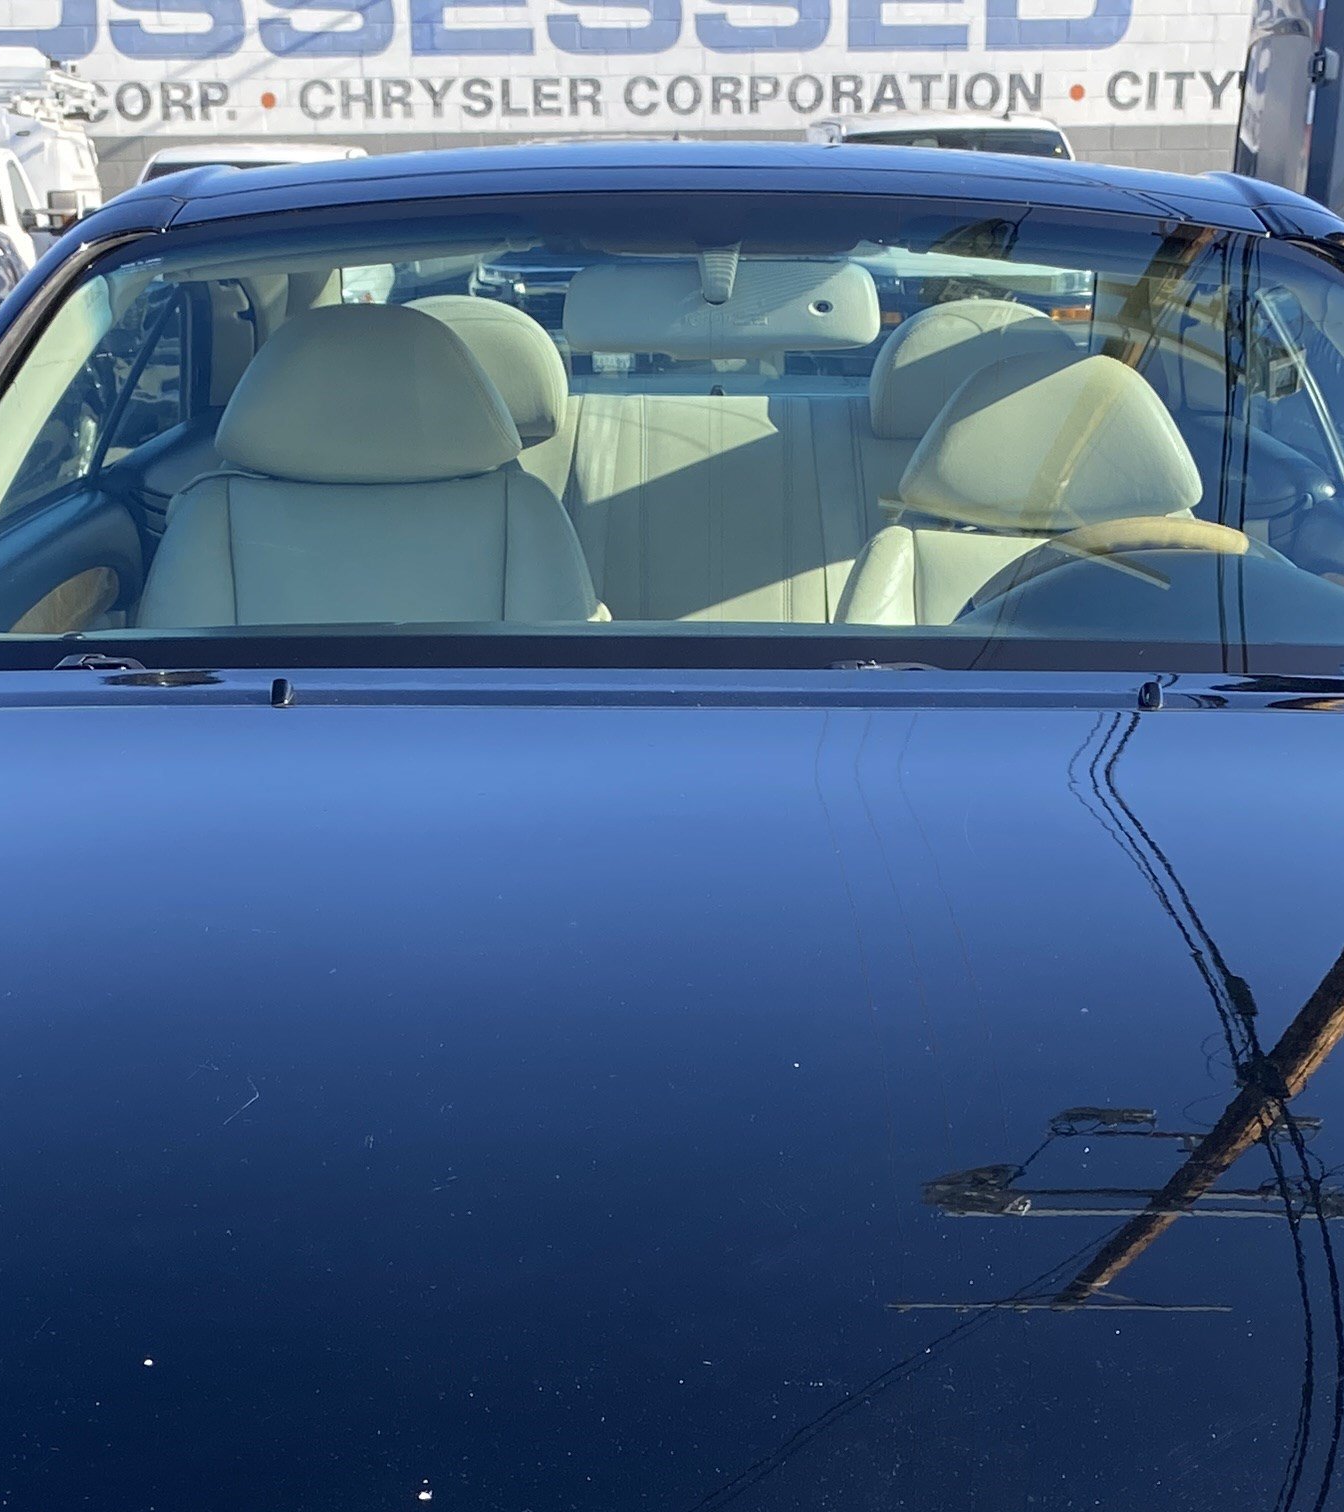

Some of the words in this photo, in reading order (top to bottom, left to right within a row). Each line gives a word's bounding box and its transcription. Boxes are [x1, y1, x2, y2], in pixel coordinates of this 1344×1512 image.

[299, 78, 602, 120] CHRYSLER
[623, 71, 1042, 116] CORPORATION
[1107, 69, 1237, 112] CITY
